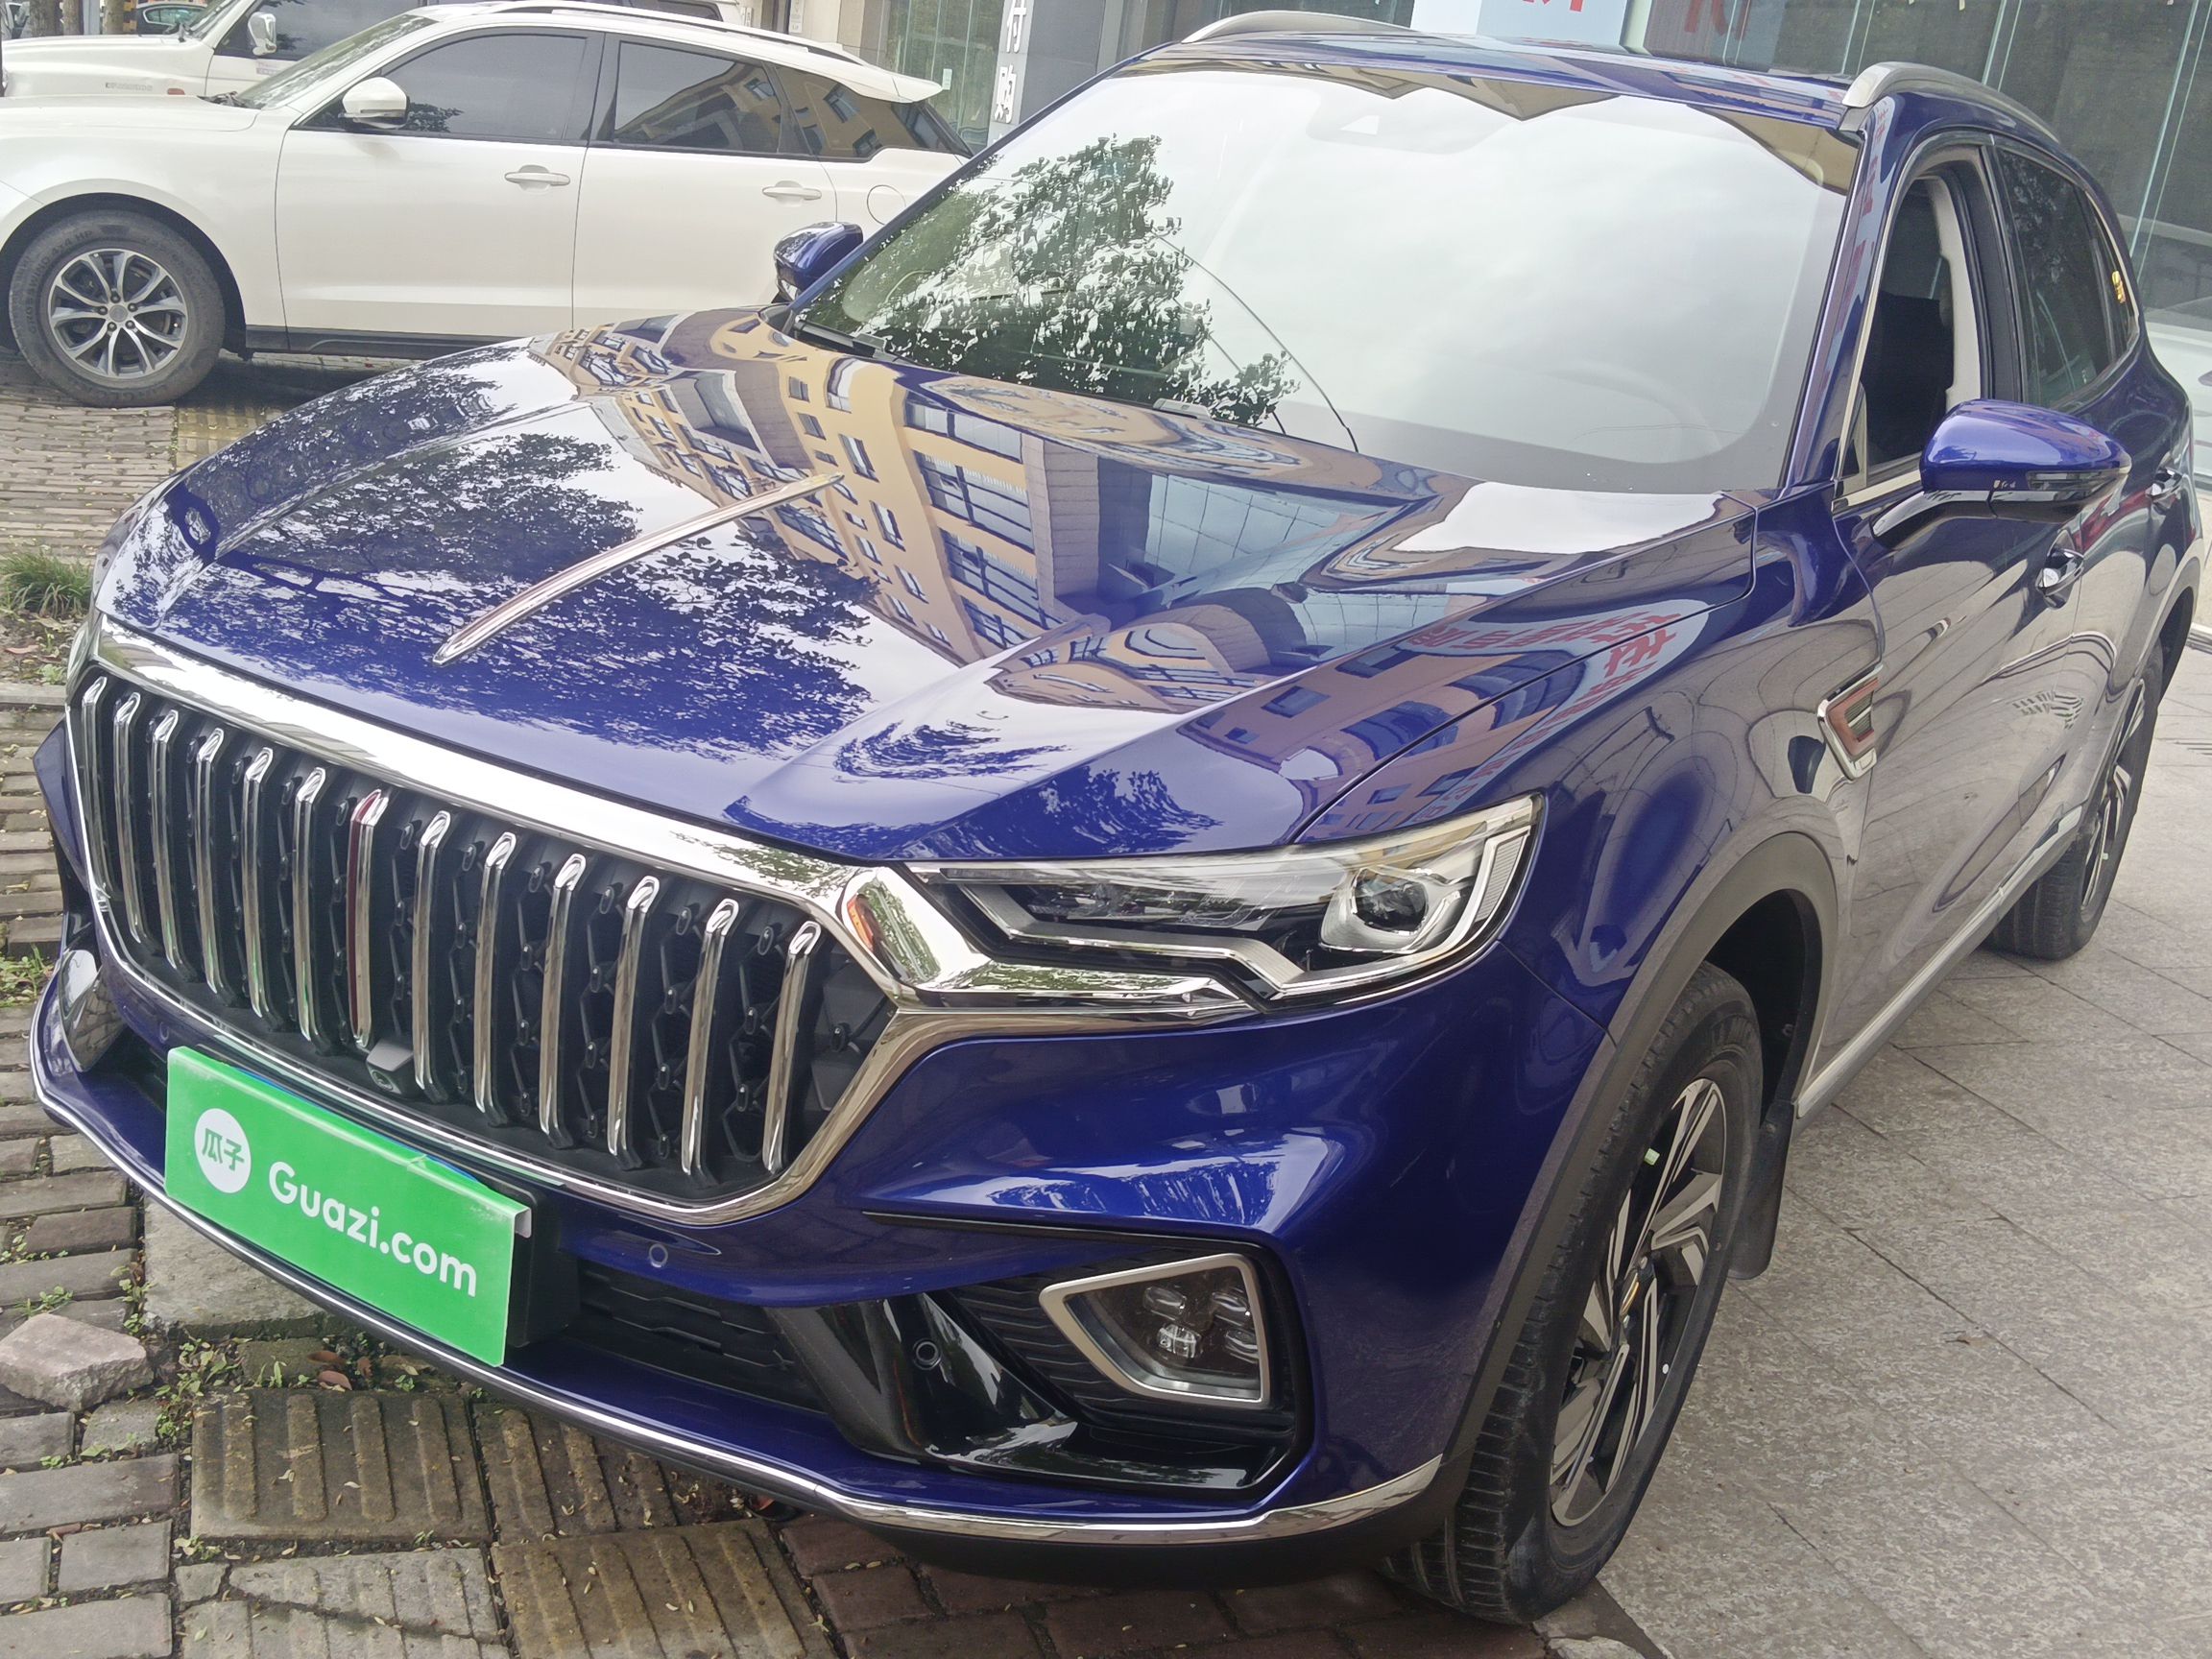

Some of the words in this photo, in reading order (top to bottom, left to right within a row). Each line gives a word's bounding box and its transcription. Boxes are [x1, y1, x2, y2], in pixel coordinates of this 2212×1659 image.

[994, 0, 1026, 143] 付购
[202, 1127, 245, 1171] 瓜子
[268, 1161, 477, 1297] Guazi.com
